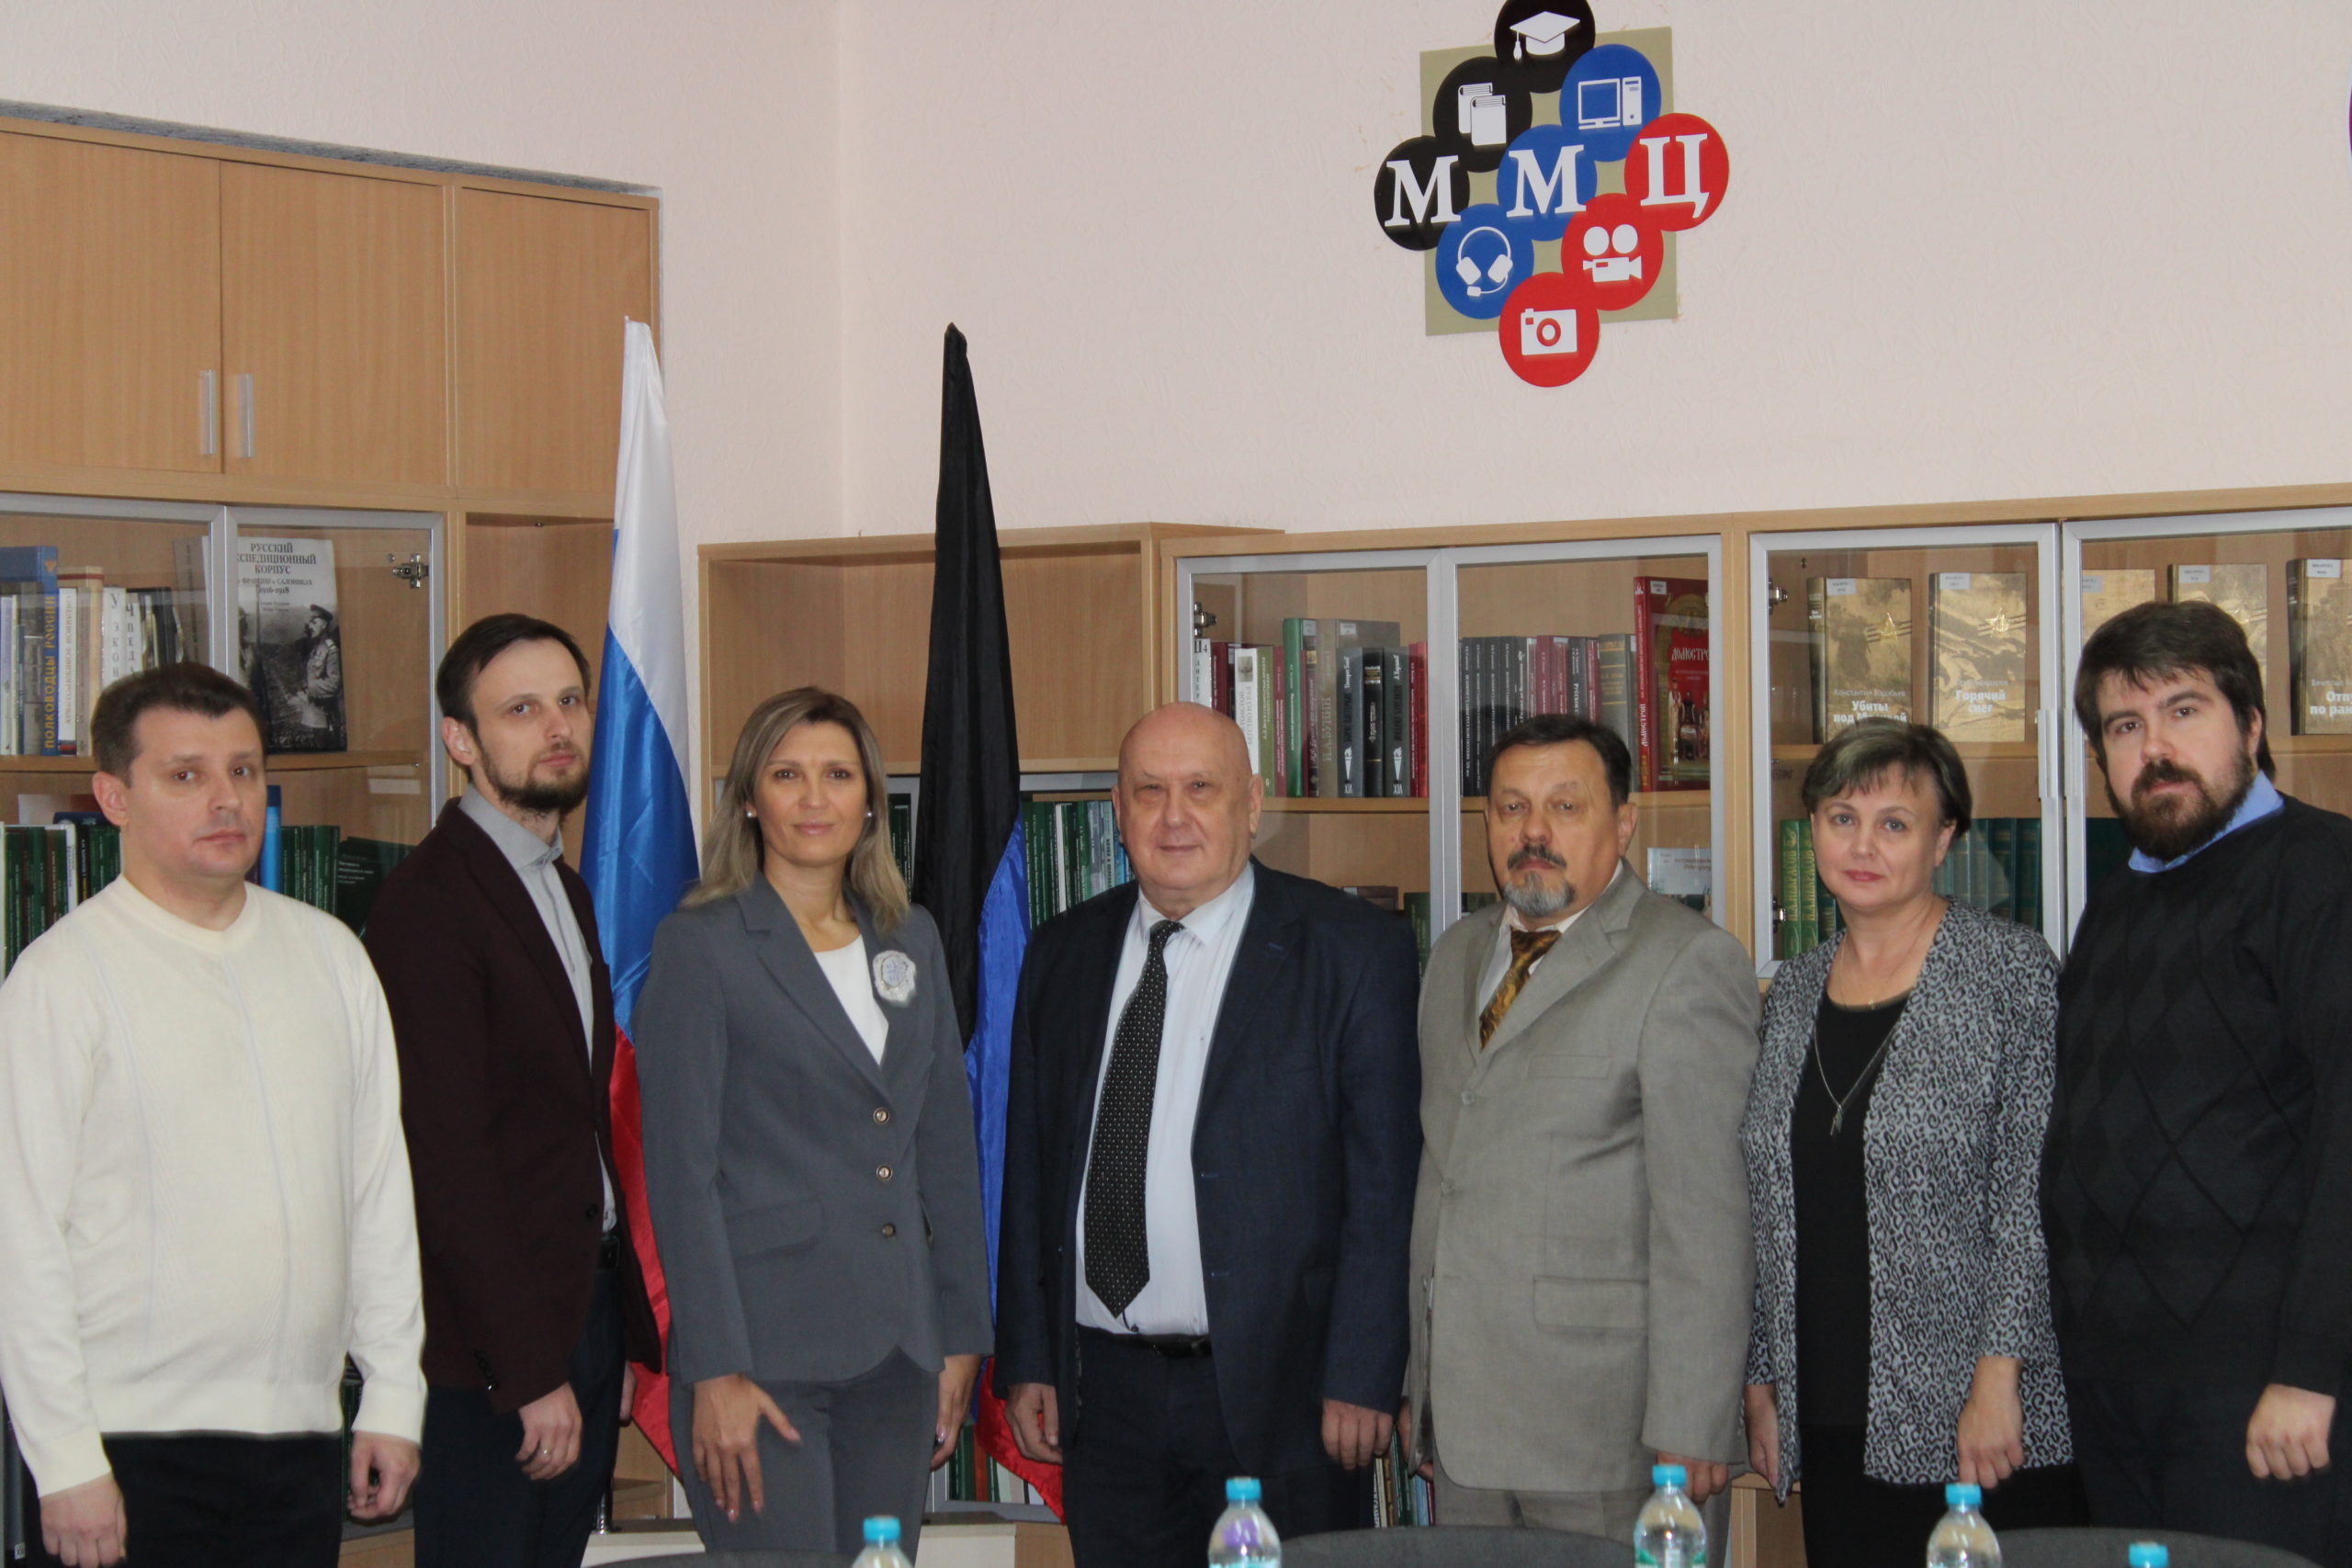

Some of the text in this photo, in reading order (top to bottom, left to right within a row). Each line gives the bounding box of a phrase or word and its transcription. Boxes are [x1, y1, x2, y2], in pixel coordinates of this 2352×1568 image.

[250, 542, 293, 553] РУССКИЙ
[238, 553, 317, 565] СПЕДИЦИОННЫЙ
[254, 565, 291, 574] КОРПУС
[43, 595, 56, 749] ПОЛКОВОДЦЫ РОССИИ
[1955, 689, 2007, 704] Горячий
[1851, 700, 1889, 713] Убиты
[1969, 705, 1993, 714] снег
[2310, 705, 2326, 715] по
[1833, 714, 1855, 726] под
